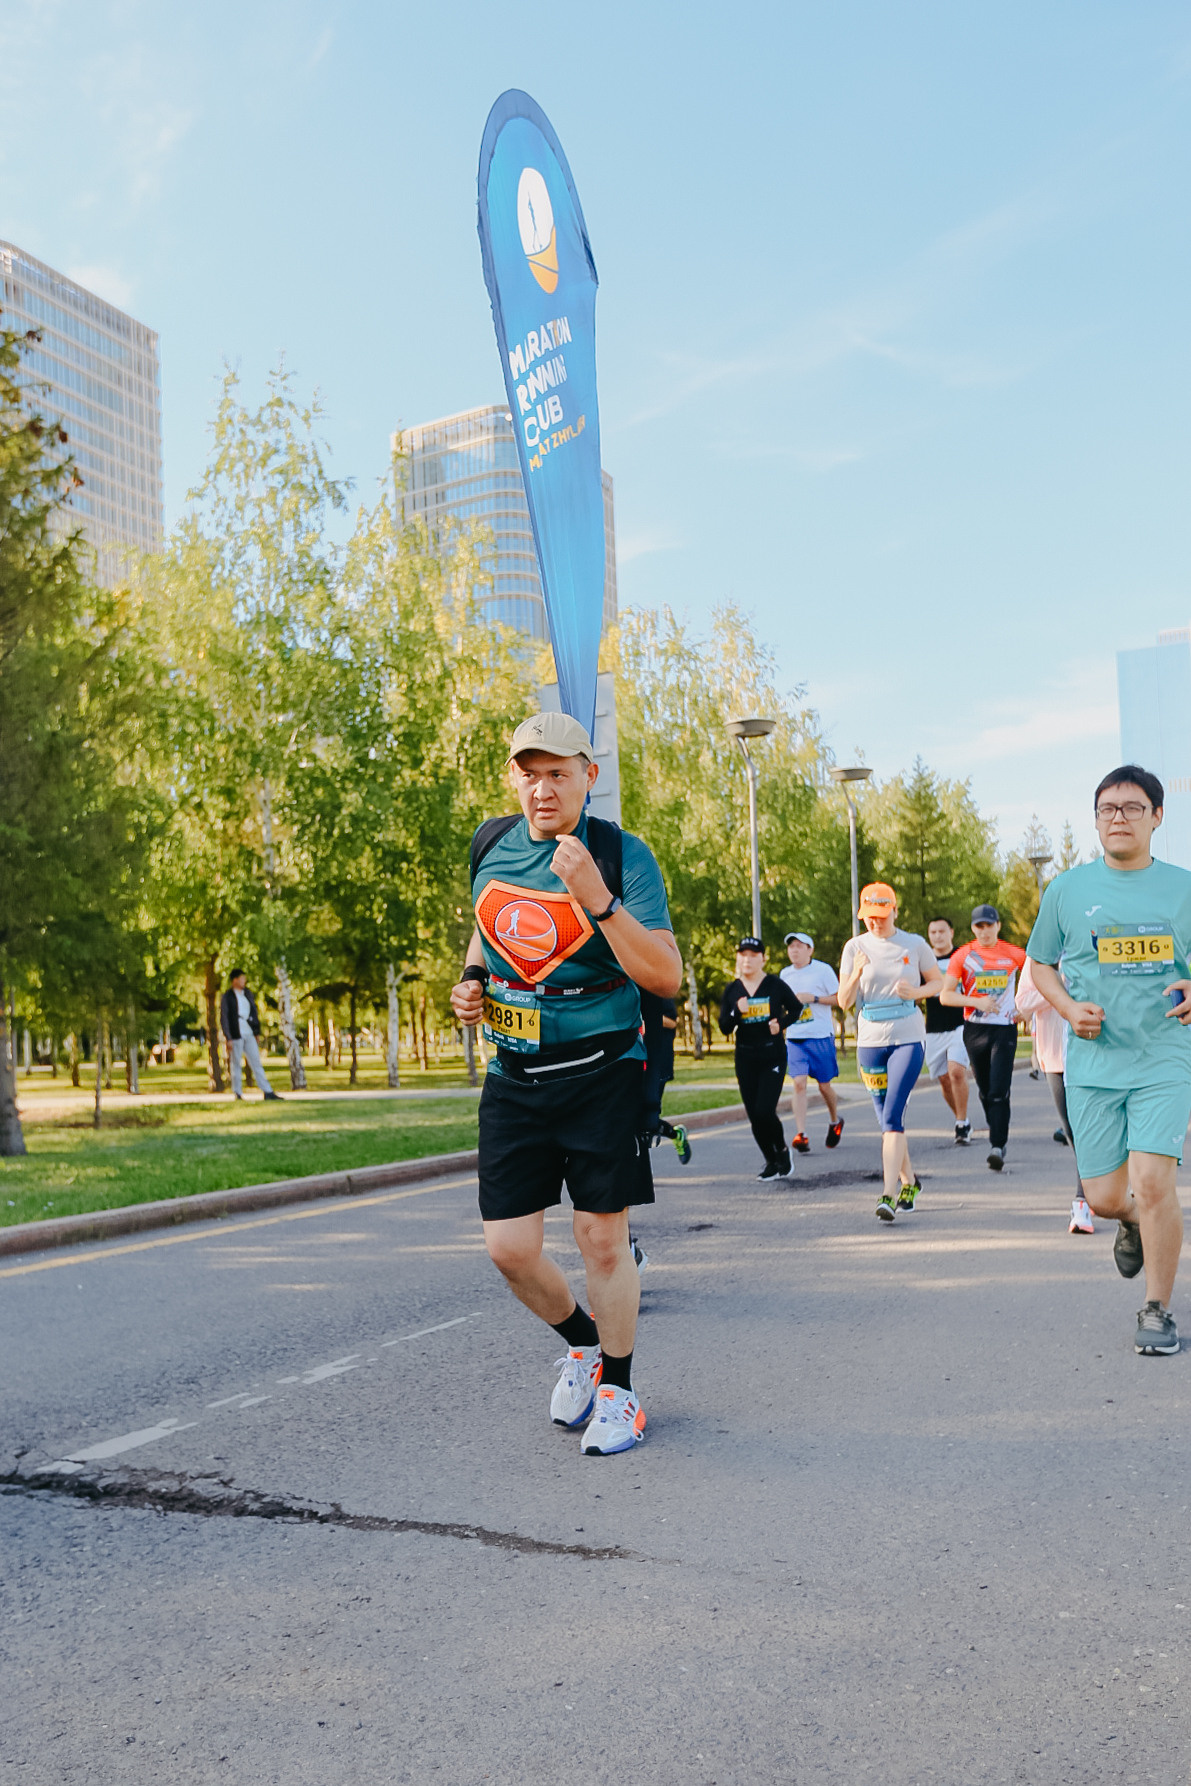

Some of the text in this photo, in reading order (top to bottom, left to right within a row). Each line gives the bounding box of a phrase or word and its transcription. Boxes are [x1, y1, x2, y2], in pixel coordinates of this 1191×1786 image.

[1111, 939, 1161, 956] 3316
[512, 995, 531, 1003] GROUP
[488, 1002, 523, 1030] 2981
